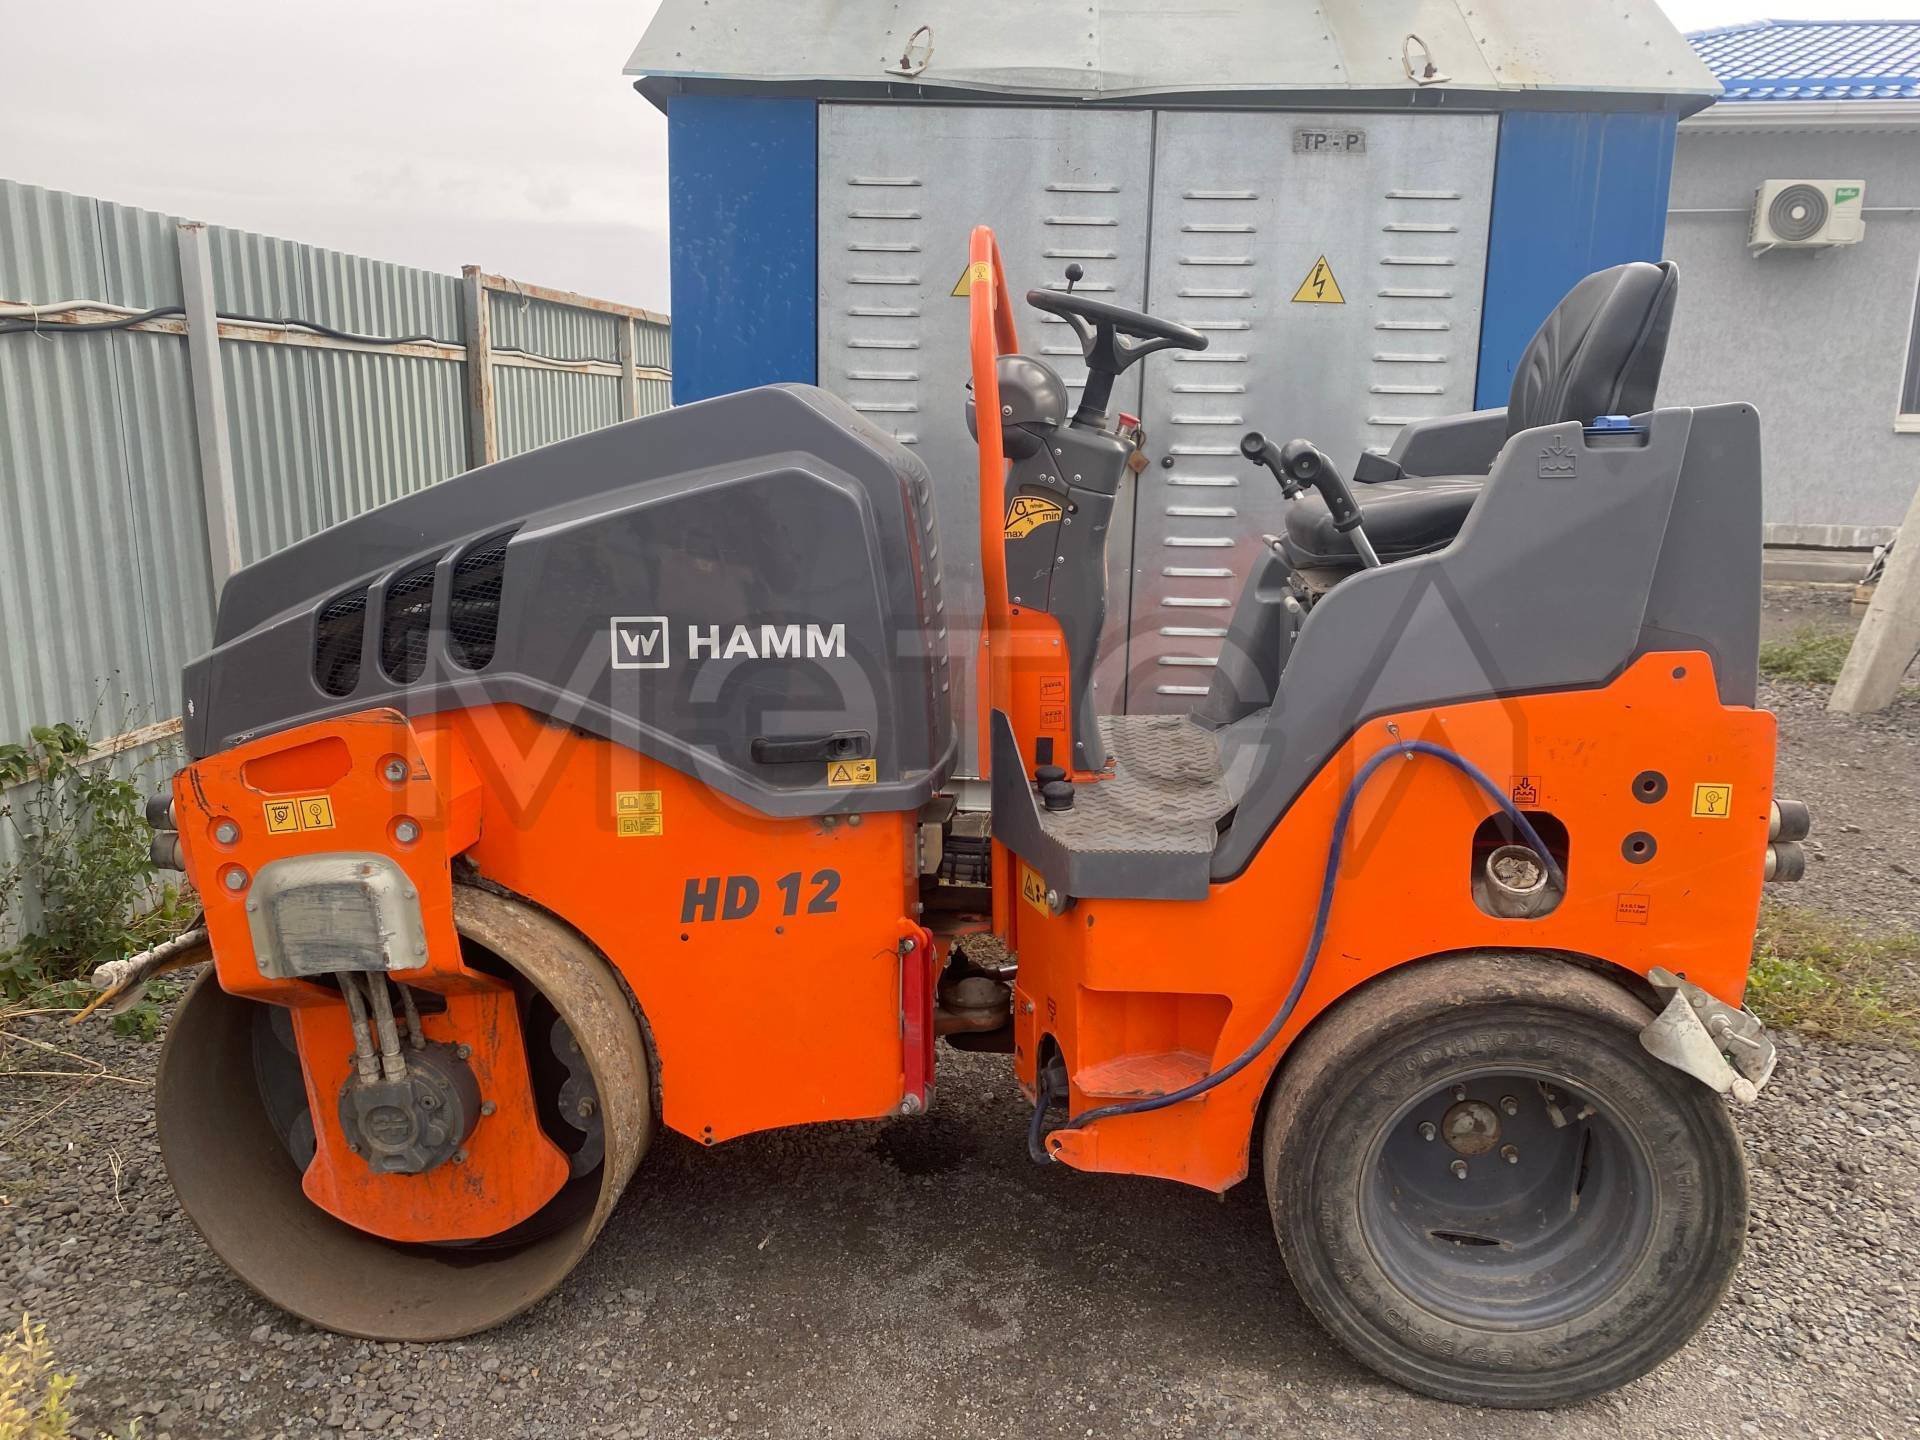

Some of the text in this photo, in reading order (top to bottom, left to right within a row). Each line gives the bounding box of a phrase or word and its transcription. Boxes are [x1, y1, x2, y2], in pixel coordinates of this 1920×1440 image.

[1042, 512, 1060, 521] min
[1003, 530, 1024, 538] max
[688, 623, 846, 660] HAMM
[680, 868, 841, 923] HD 12
